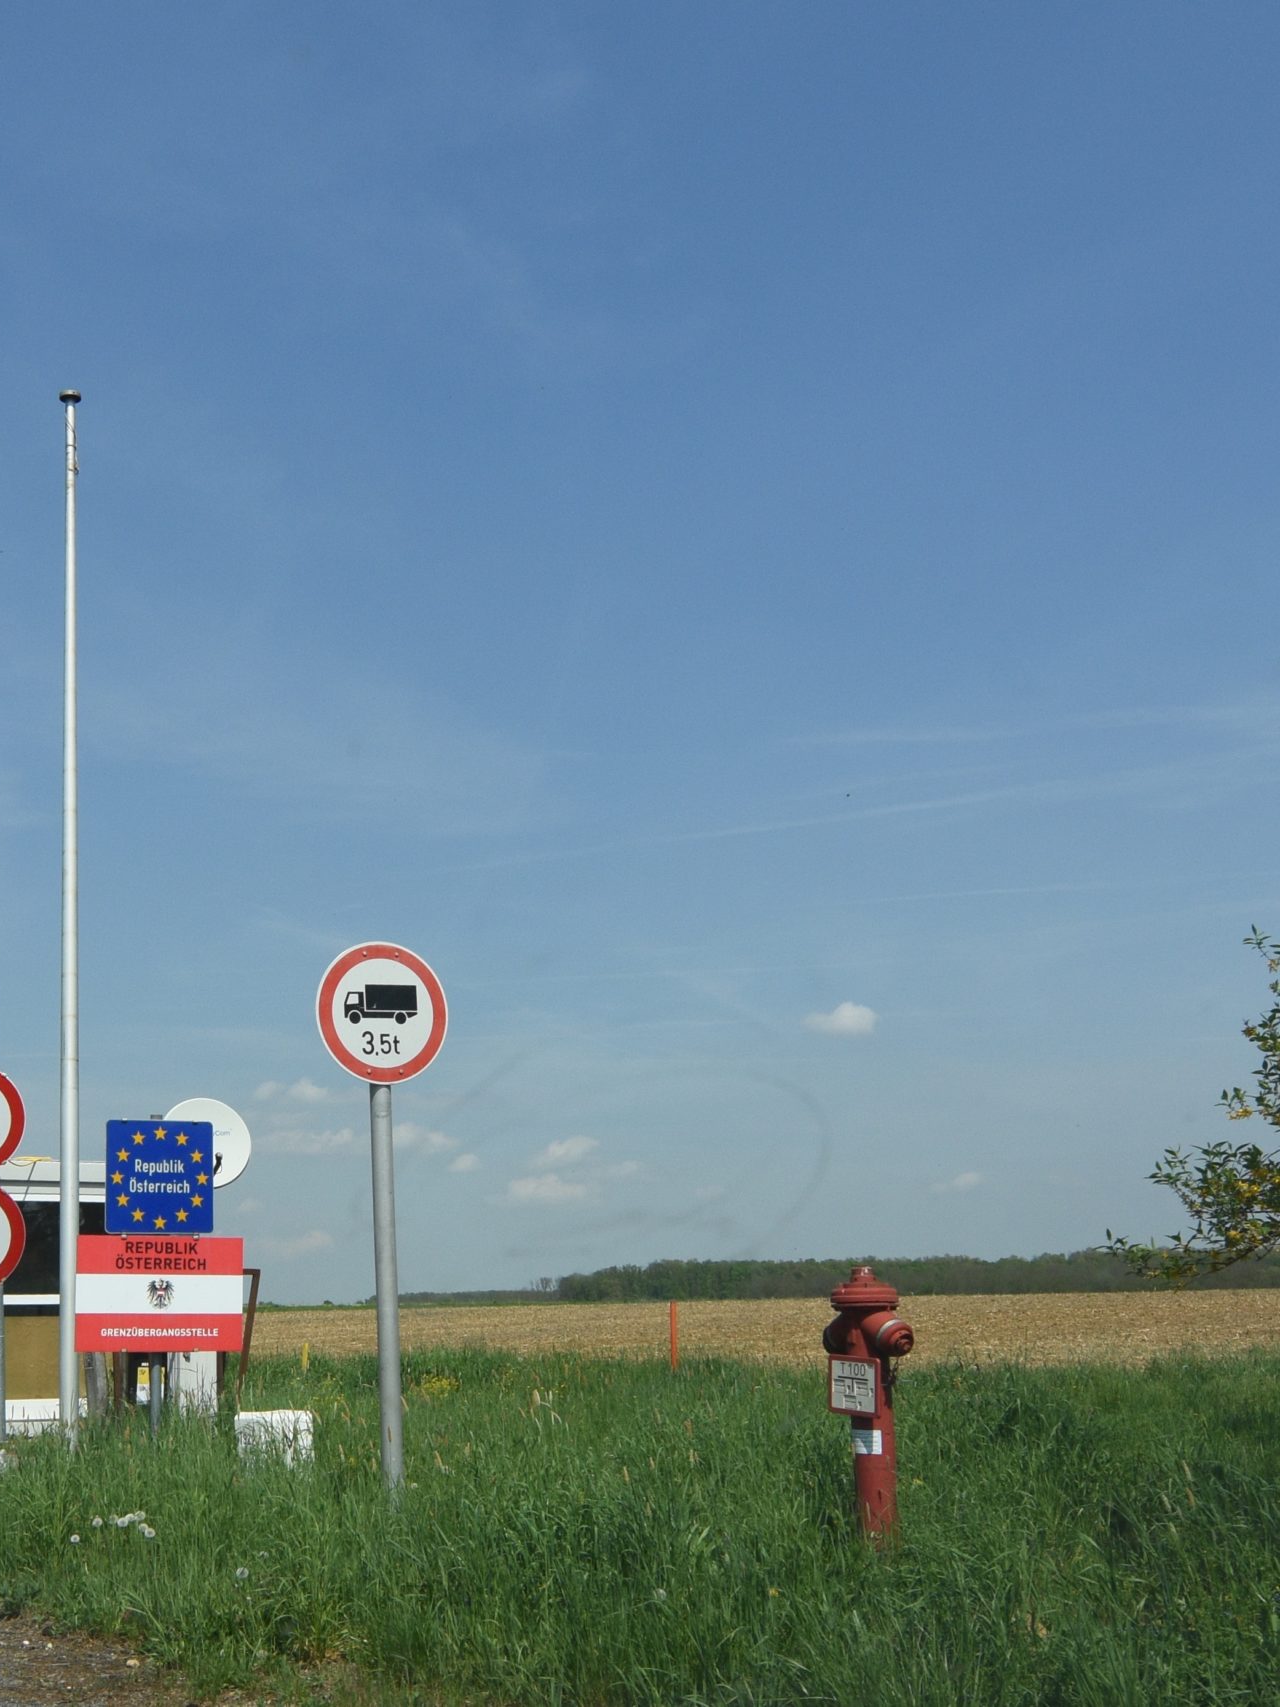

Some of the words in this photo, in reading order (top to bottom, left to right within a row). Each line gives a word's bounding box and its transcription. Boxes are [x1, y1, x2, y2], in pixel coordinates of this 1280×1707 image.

[134, 1159, 185, 1176] Republik
[129, 1179, 190, 1194] Österreich
[125, 1241, 198, 1255] REPUBLIK
[115, 1256, 206, 1270] ÖSTERREICH
[101, 1327, 219, 1337] GRENZÜBERGANGSSTELLE
[848, 1363, 866, 1376] 100
